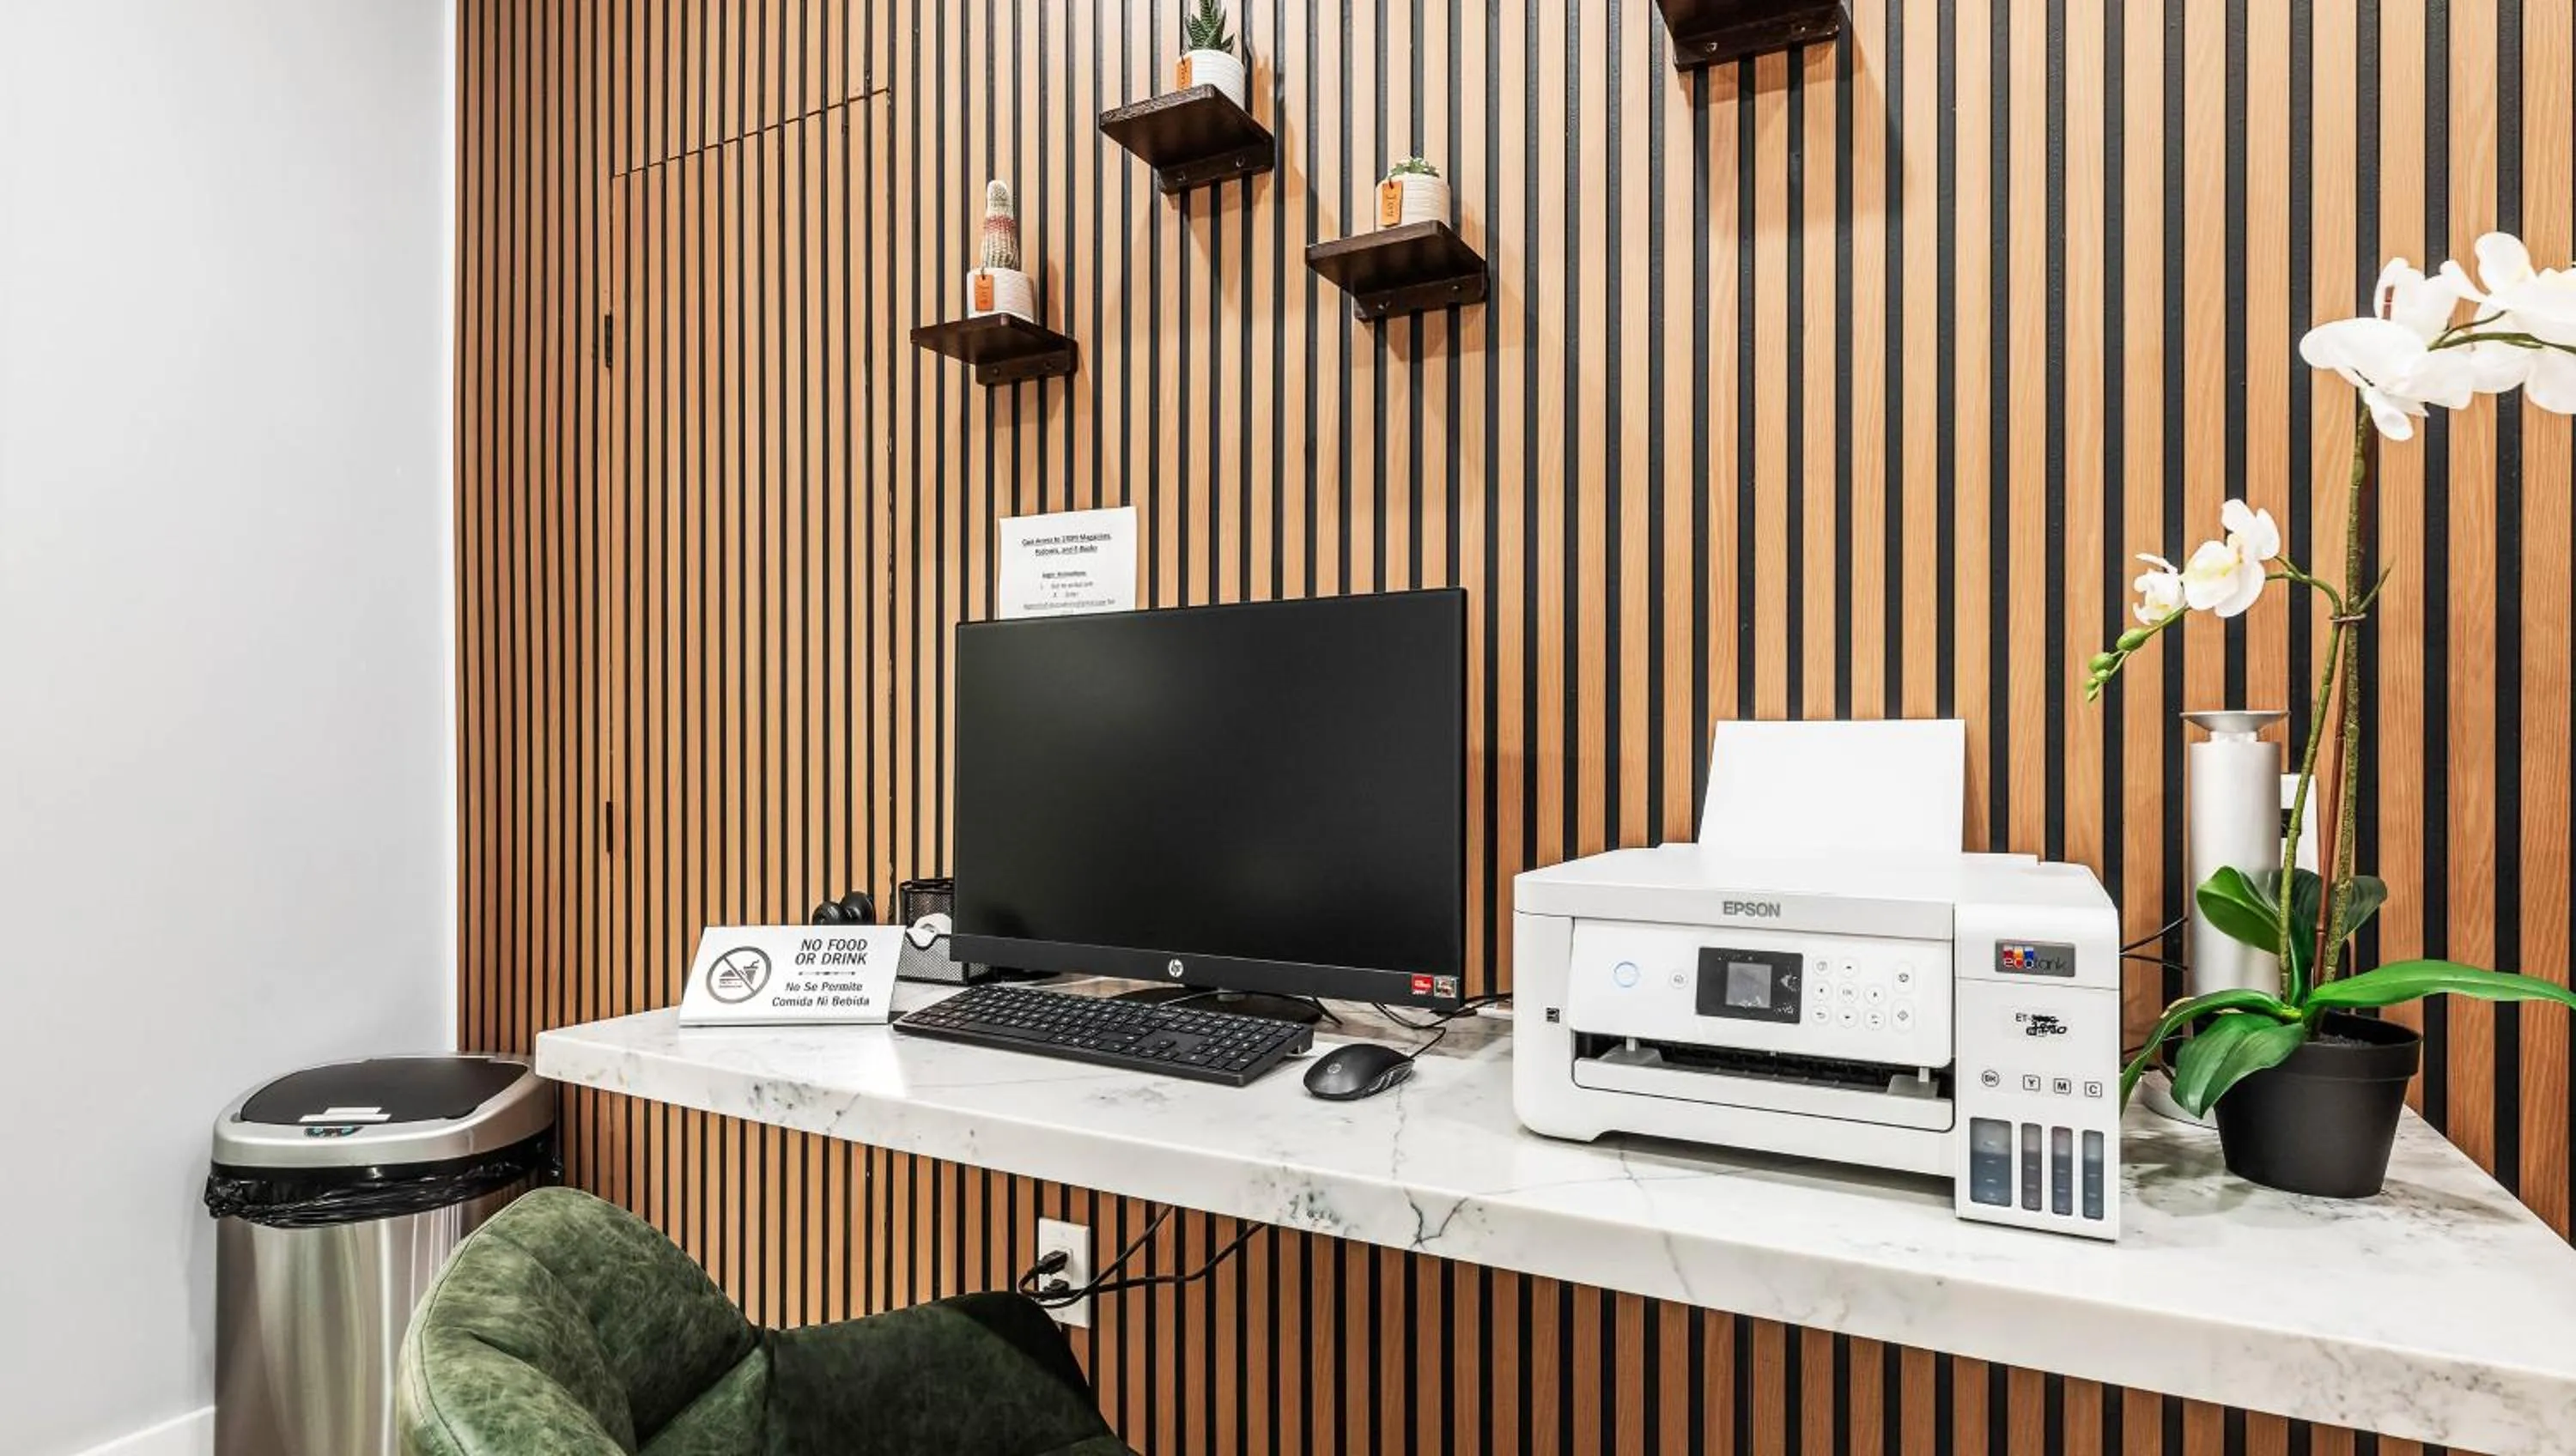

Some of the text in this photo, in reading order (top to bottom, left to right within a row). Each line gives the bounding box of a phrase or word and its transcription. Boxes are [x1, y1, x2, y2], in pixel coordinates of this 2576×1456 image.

[1723, 901, 1781, 918] EPSON
[800, 938, 868, 951] NO FOOD
[795, 952, 868, 965] OR DRINK
[785, 982, 863, 992] No Se Permite
[772, 996, 870, 1007] Comida Ni Bebida
[2057, 1081, 2067, 1091] M
[2088, 1084, 2098, 1095] C
